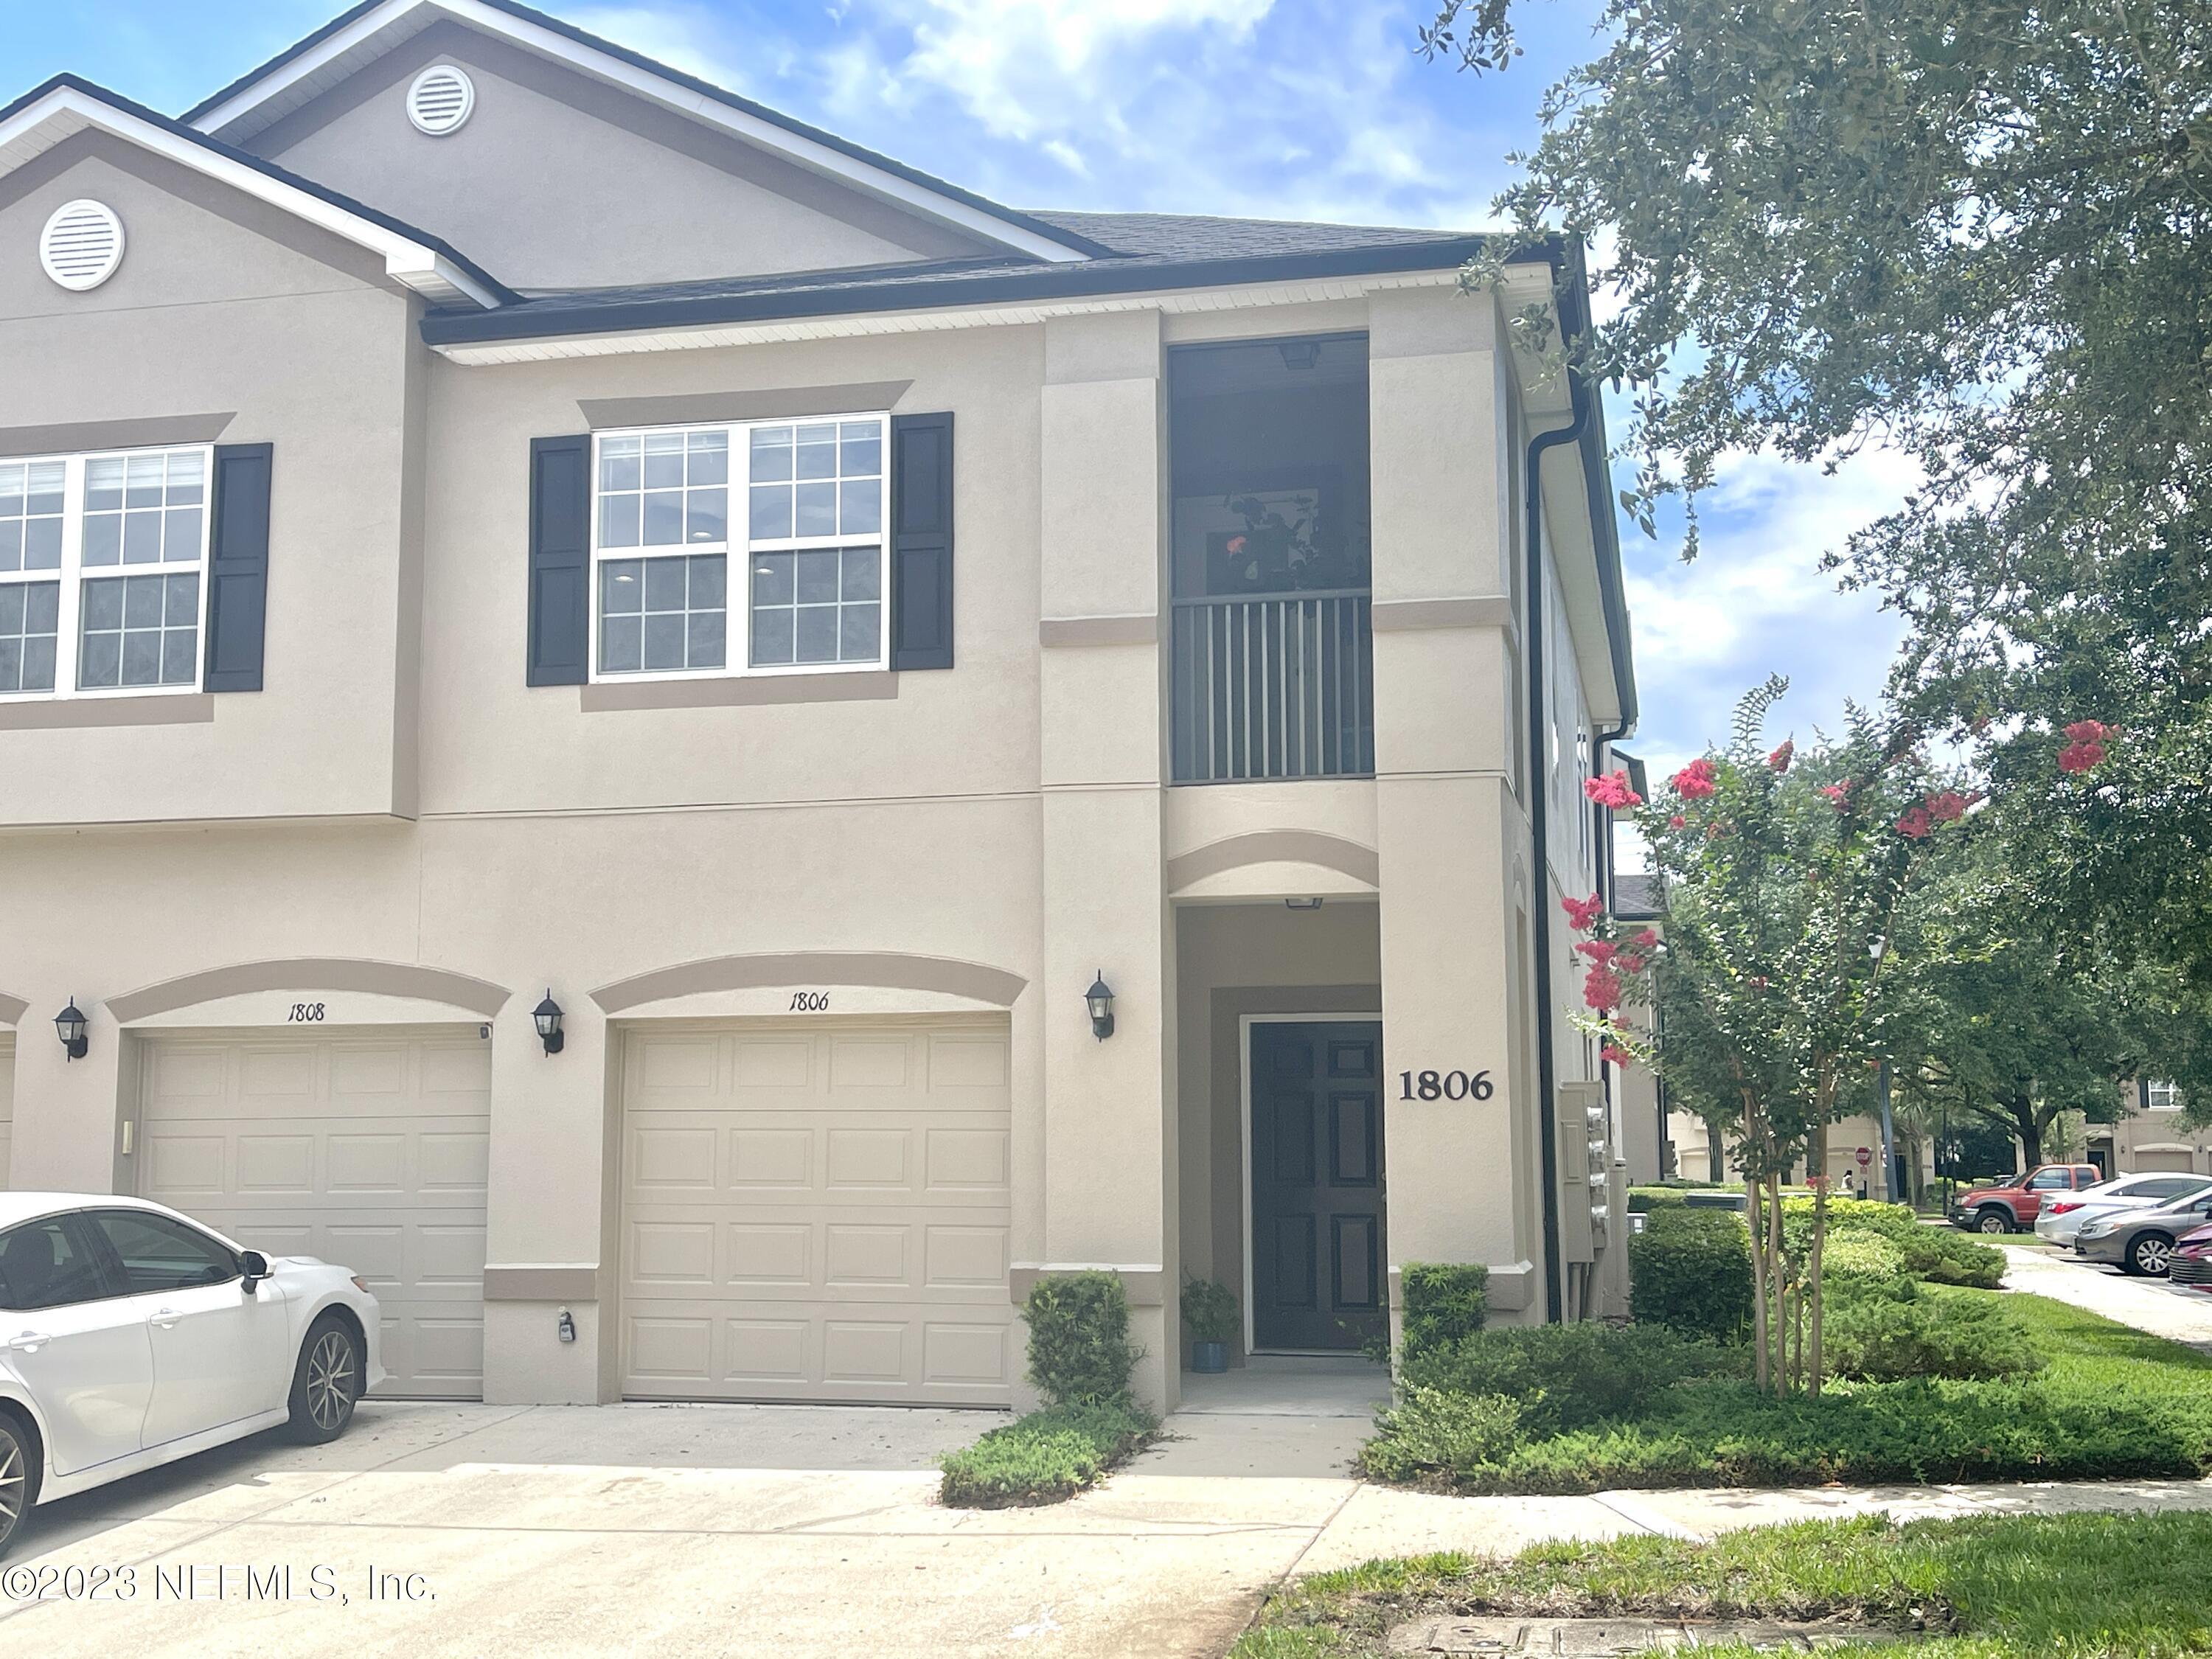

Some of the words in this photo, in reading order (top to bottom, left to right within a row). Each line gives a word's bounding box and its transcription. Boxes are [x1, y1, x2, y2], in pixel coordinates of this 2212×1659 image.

[788, 991, 830, 1011] 1806
[288, 1003, 324, 1021] 1808
[1399, 1070, 1493, 1101] 1806
